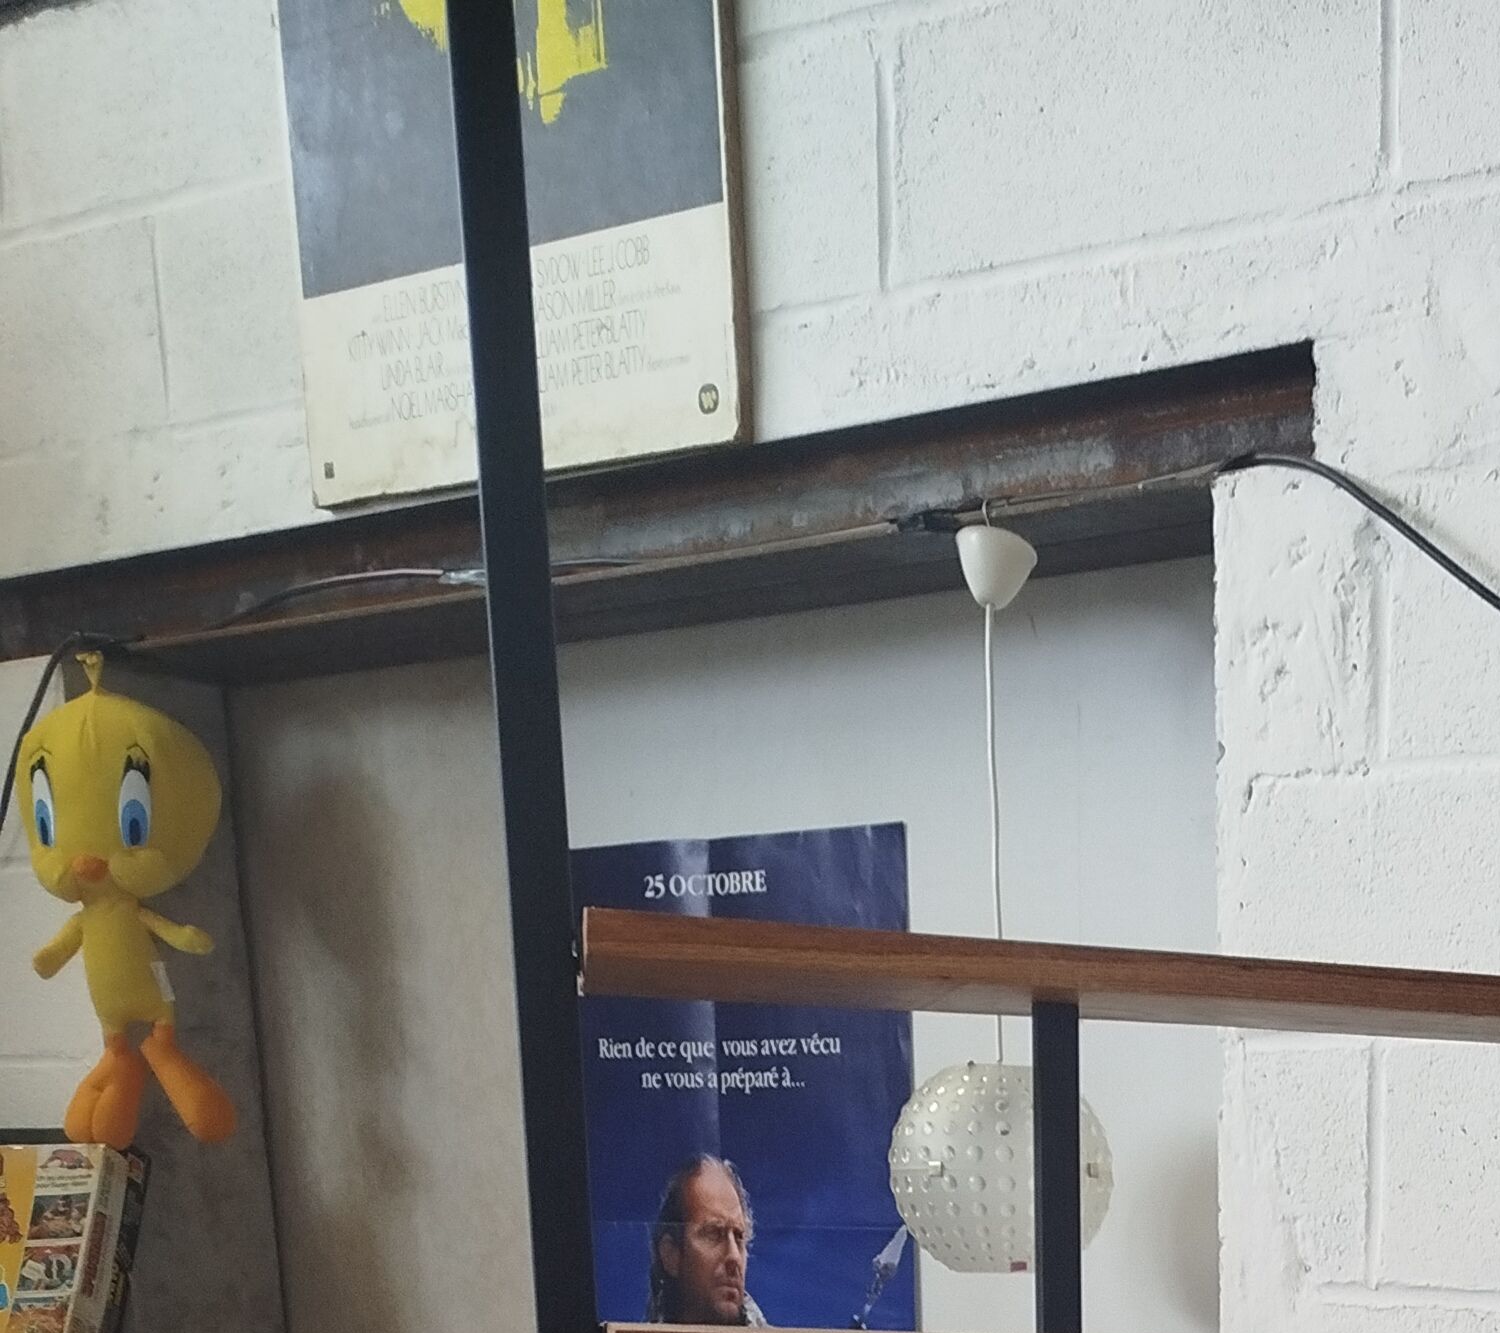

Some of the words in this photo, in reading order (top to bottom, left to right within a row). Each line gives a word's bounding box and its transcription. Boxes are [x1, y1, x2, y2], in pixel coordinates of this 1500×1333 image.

[536, 289, 574, 321] ASON
[644, 873, 665, 899] 25
[668, 869, 767, 897] OCTOBRE
[598, 1037, 632, 1059] Rien
[635, 1036, 656, 1058] de
[657, 1041, 678, 1058] ce
[679, 1040, 714, 1064] que
[722, 1040, 759, 1057] vous
[760, 1038, 797, 1055] avez
[800, 1032, 841, 1055] vécu
[641, 1071, 662, 1089] ne
[663, 1071, 704, 1088] vous
[707, 1071, 718, 1088] a
[720, 1066, 780, 1095] préparé
[781, 1066, 806, 1089] à...
